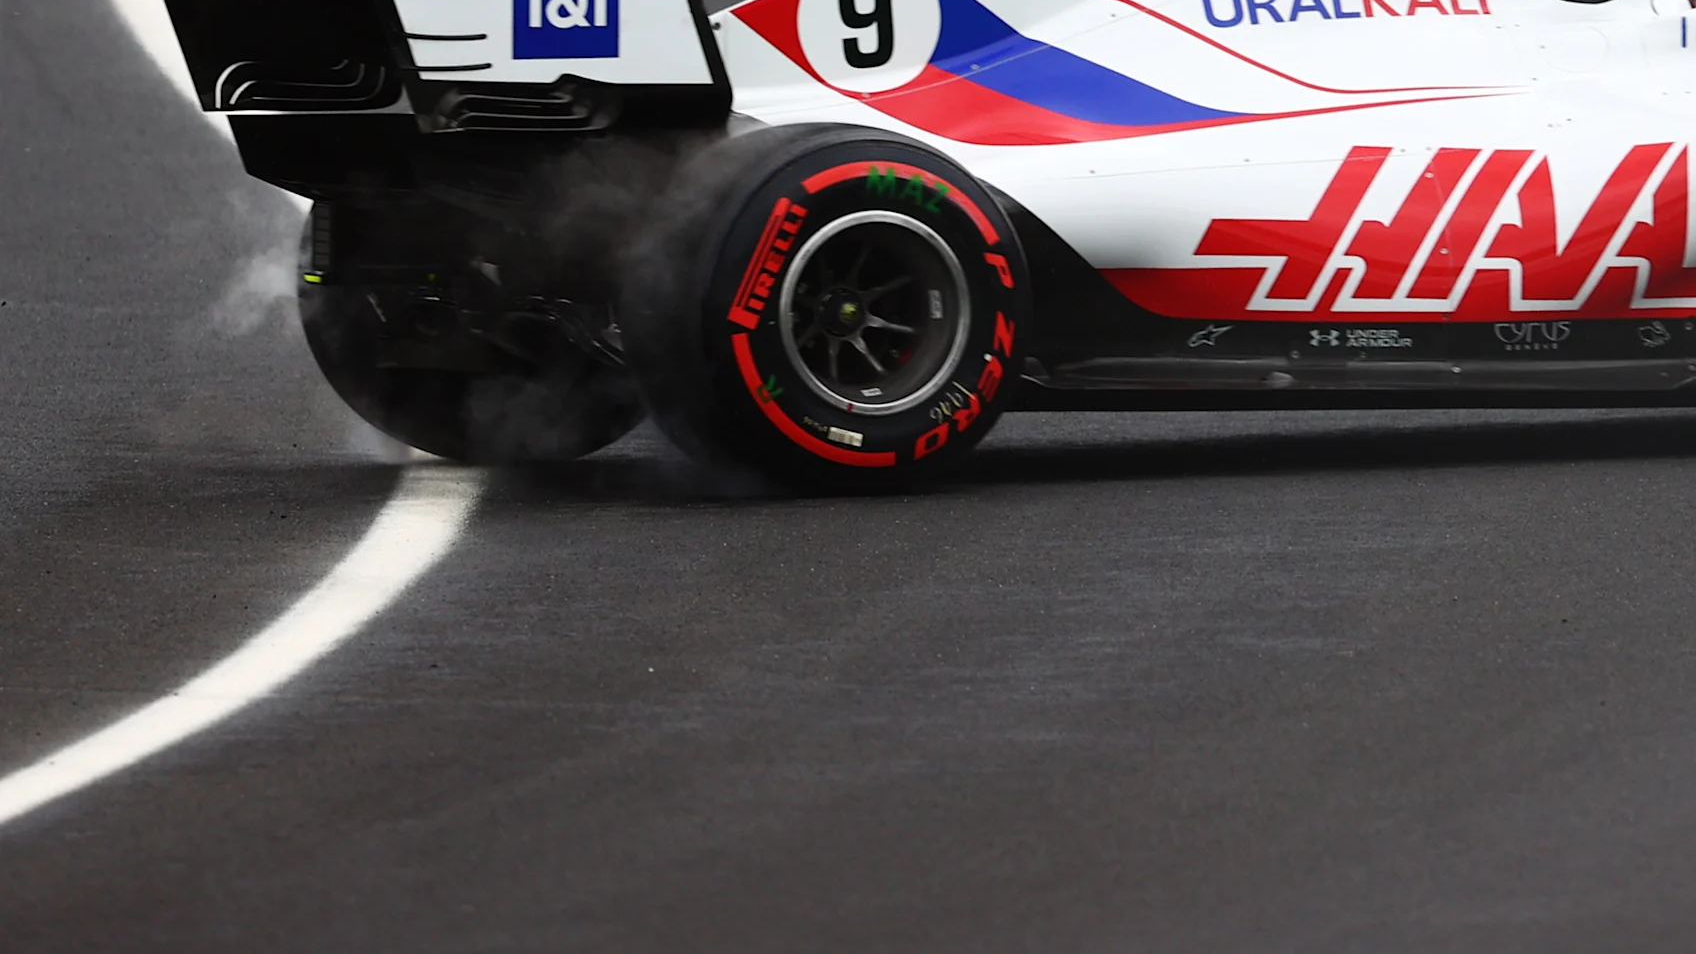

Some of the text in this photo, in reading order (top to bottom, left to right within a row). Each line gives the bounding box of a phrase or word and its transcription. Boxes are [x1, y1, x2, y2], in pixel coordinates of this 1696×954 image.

[865, 166, 949, 214] MAZ
[727, 197, 809, 330] PIRELLI
[914, 252, 1016, 460] P ZERO
[1346, 329, 1399, 338] UNDER
[1346, 338, 1413, 347] ARMOUR
